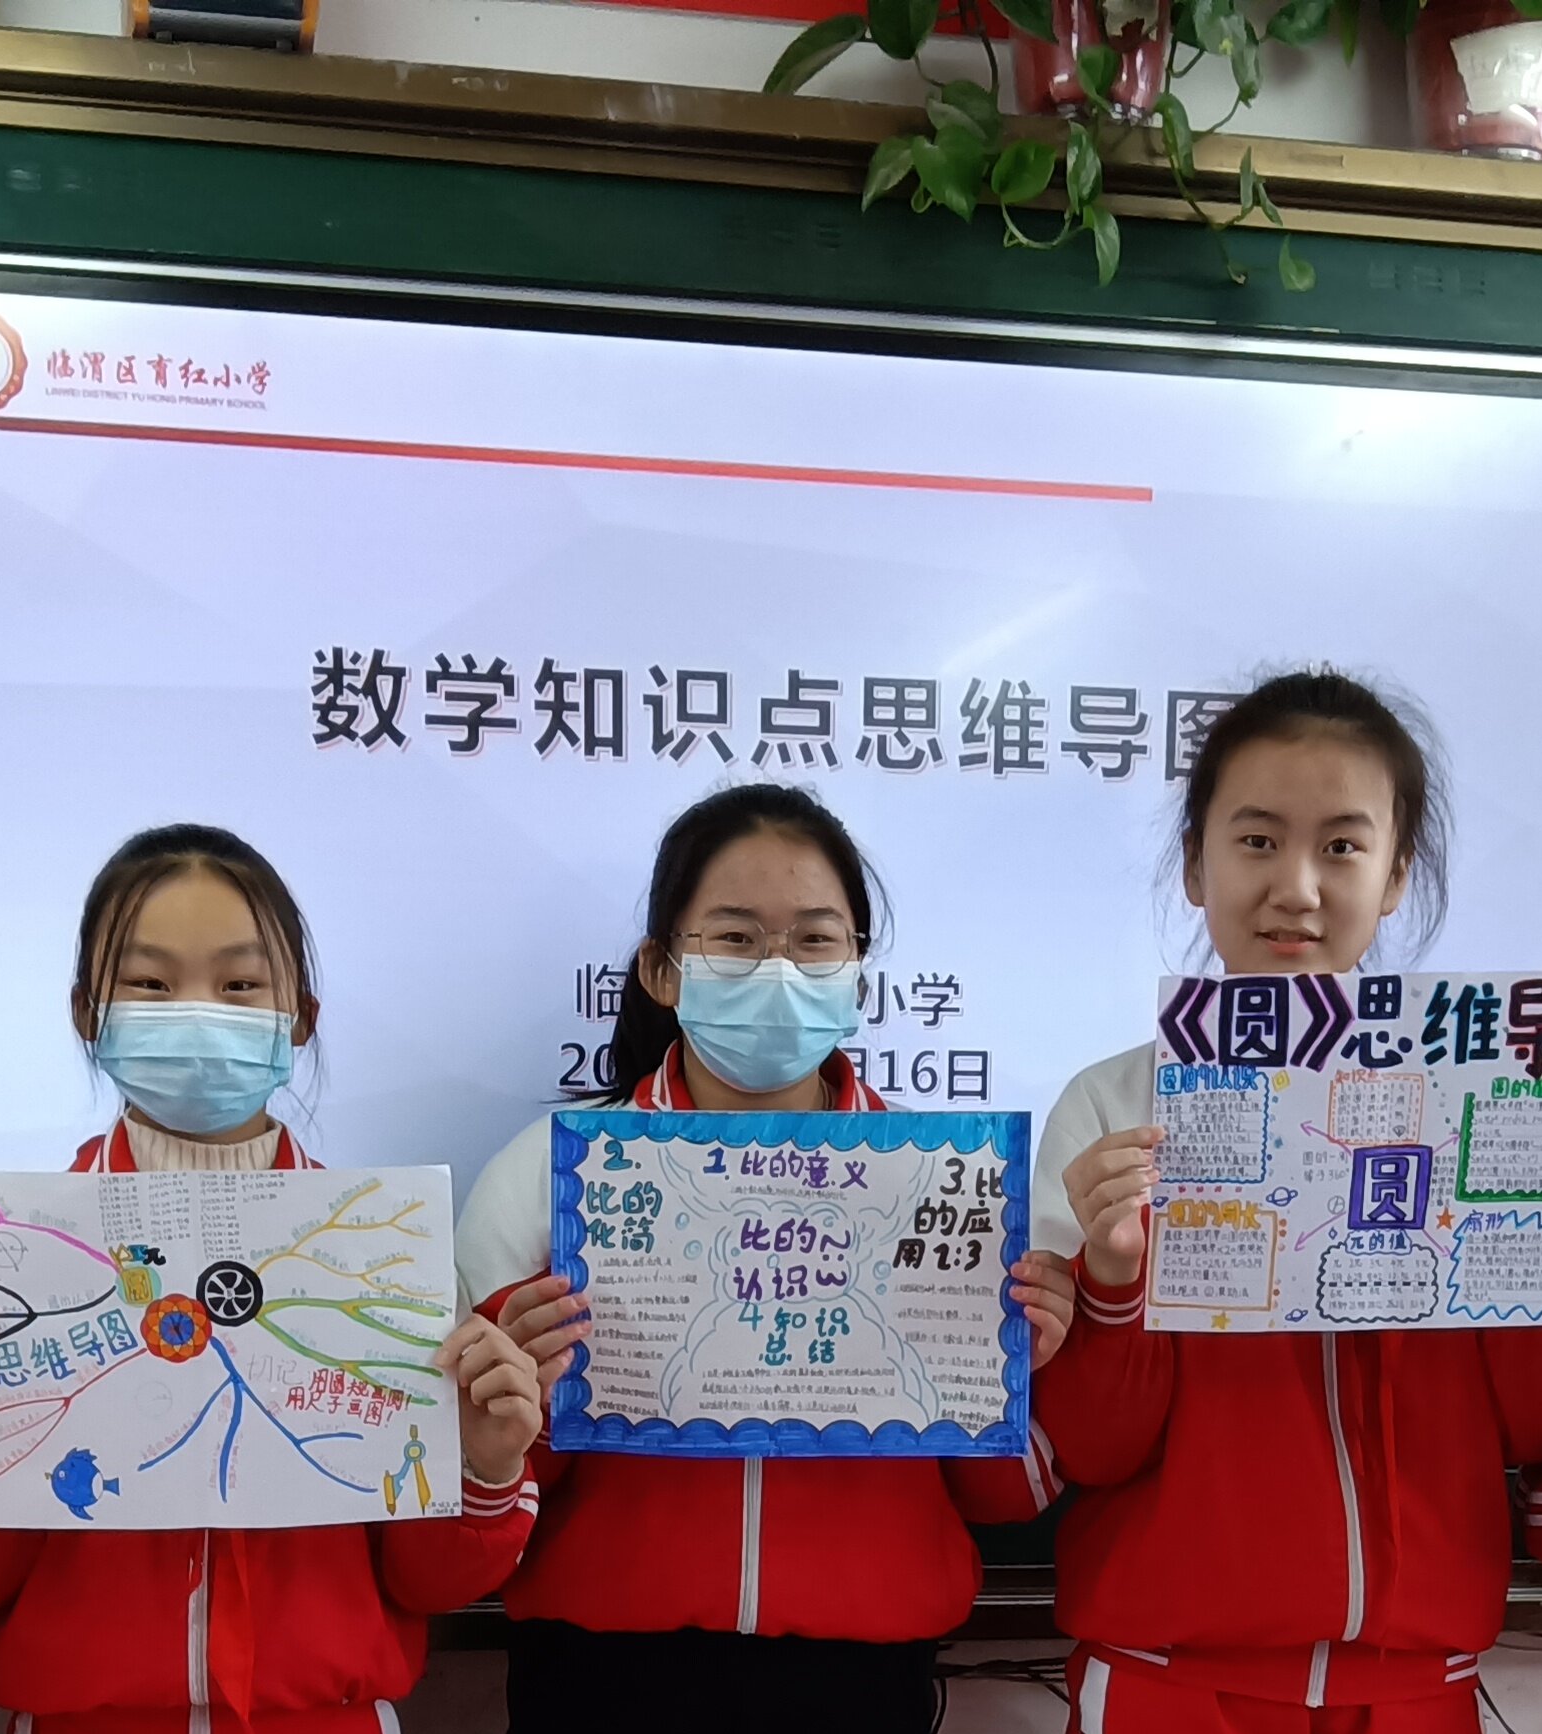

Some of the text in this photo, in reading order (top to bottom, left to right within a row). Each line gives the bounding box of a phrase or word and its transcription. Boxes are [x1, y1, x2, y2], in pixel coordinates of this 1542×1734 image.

[46, 348, 272, 395] 临渭区育红小学
[312, 646, 1250, 781] 数学知识点思维导图
[857, 972, 962, 1027] 小学
[586, 1180, 663, 1218] 比的
[1348, 1144, 1430, 1230] 圆
[740, 1217, 817, 1254] 比的
[914, 1196, 994, 1237] 的应
[733, 1264, 808, 1301] 认识
